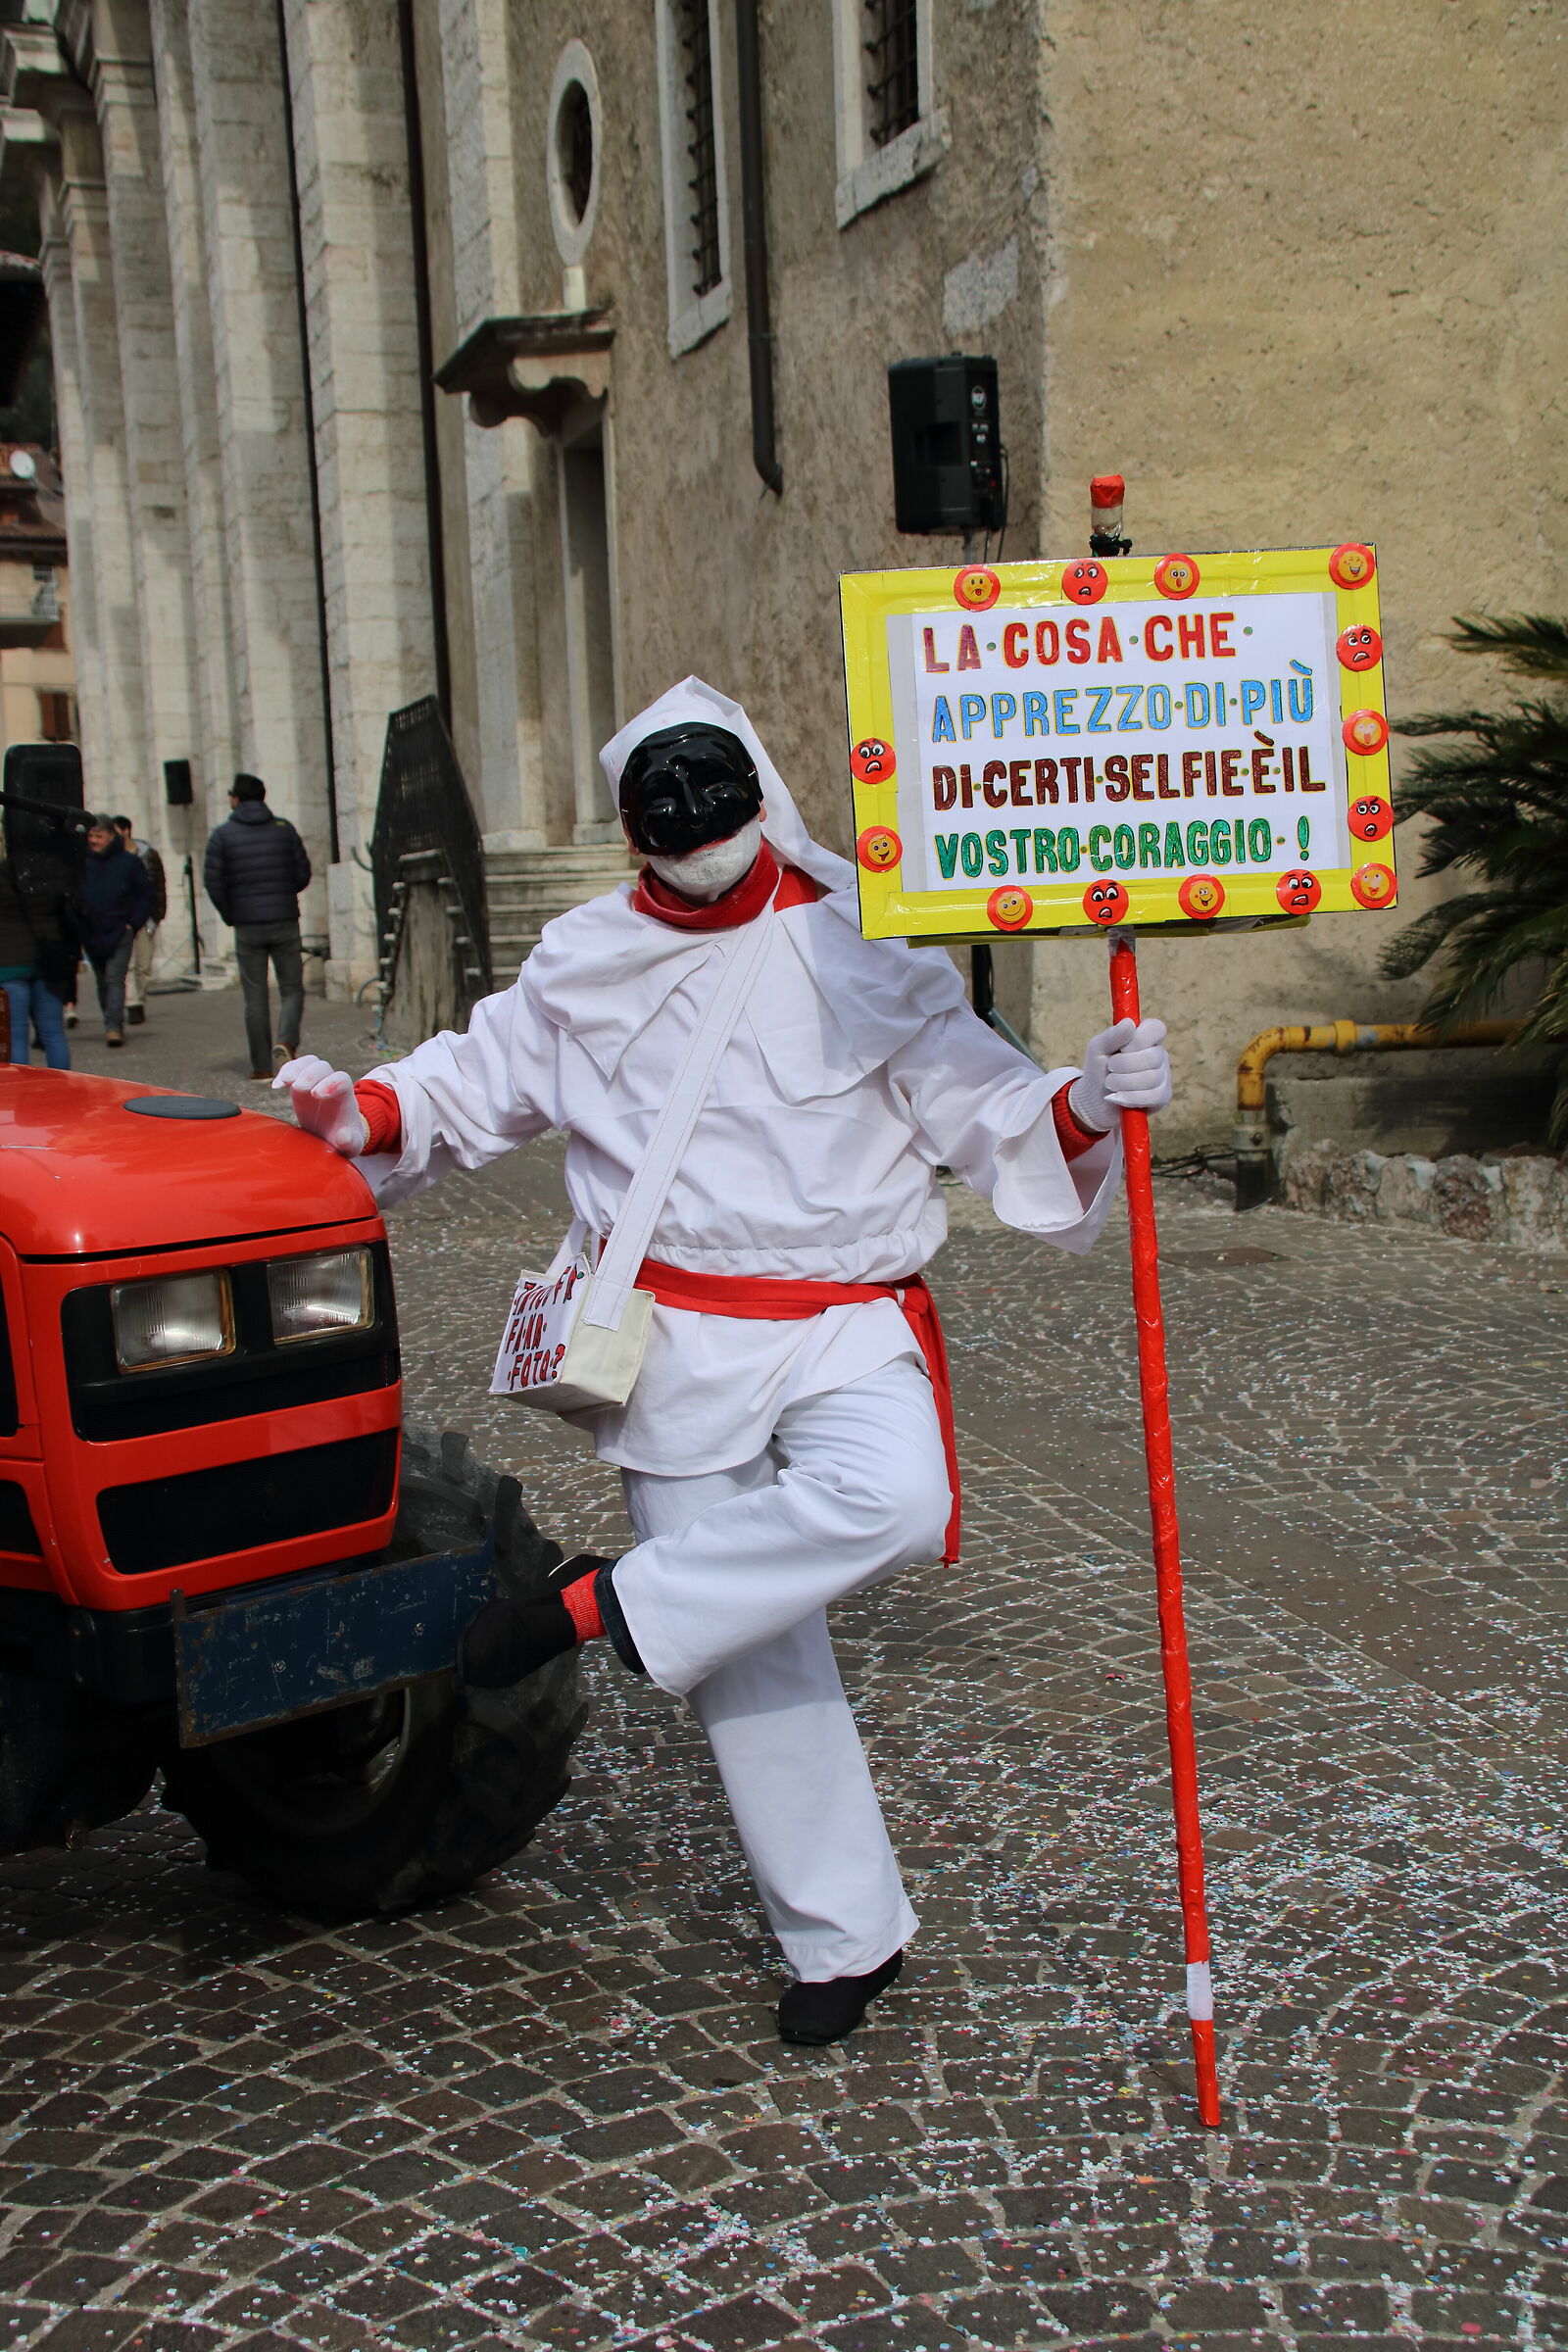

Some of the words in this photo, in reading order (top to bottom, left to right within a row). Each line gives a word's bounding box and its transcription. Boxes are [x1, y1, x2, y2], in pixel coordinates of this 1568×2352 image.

[923, 624, 982, 673] LA
[1002, 616, 1122, 669] COSA
[1144, 612, 1237, 662] CHE
[931, 683, 1172, 743] APPREZZO
[1185, 681, 1226, 729] DI
[1241, 660, 1313, 727] PIÙ
[932, 764, 973, 811] DI
[982, 757, 1094, 809] CERTI
[1103, 749, 1244, 804] SELFIE
[1252, 730, 1276, 795] È
[1282, 746, 1327, 795] IL
[934, 825, 1079, 880] VOSTRO
[1089, 817, 1271, 872] CORAGGIO
